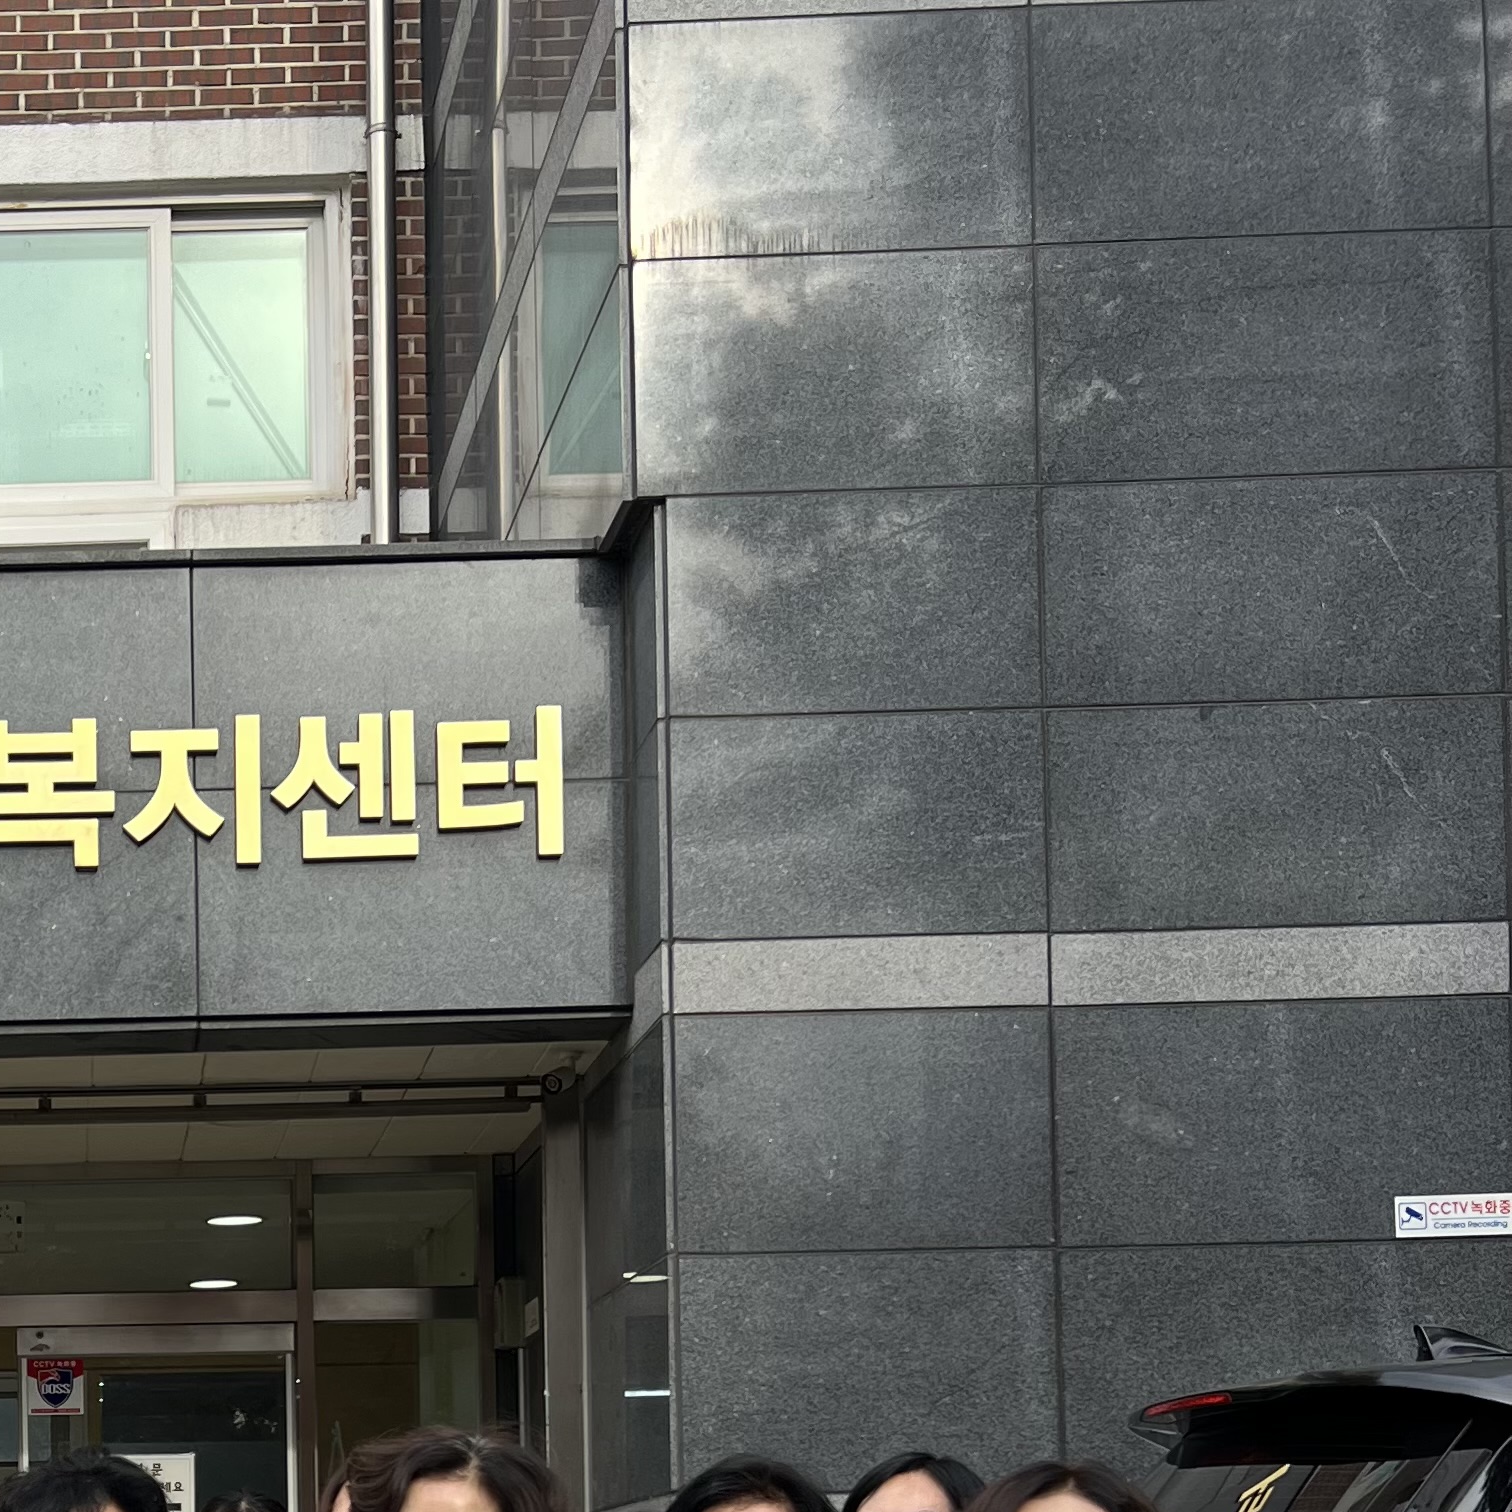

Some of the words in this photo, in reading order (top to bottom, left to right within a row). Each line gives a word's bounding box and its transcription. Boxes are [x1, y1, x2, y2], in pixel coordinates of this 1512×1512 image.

[1429, 1201, 1468, 1215] CCTV
[1471, 1199, 1511, 1215] 녹화중
[1434, 1221, 1465, 1229] Camera
[1468, 1220, 1508, 1229] Recording
[33, 1360, 55, 1368] CCTV
